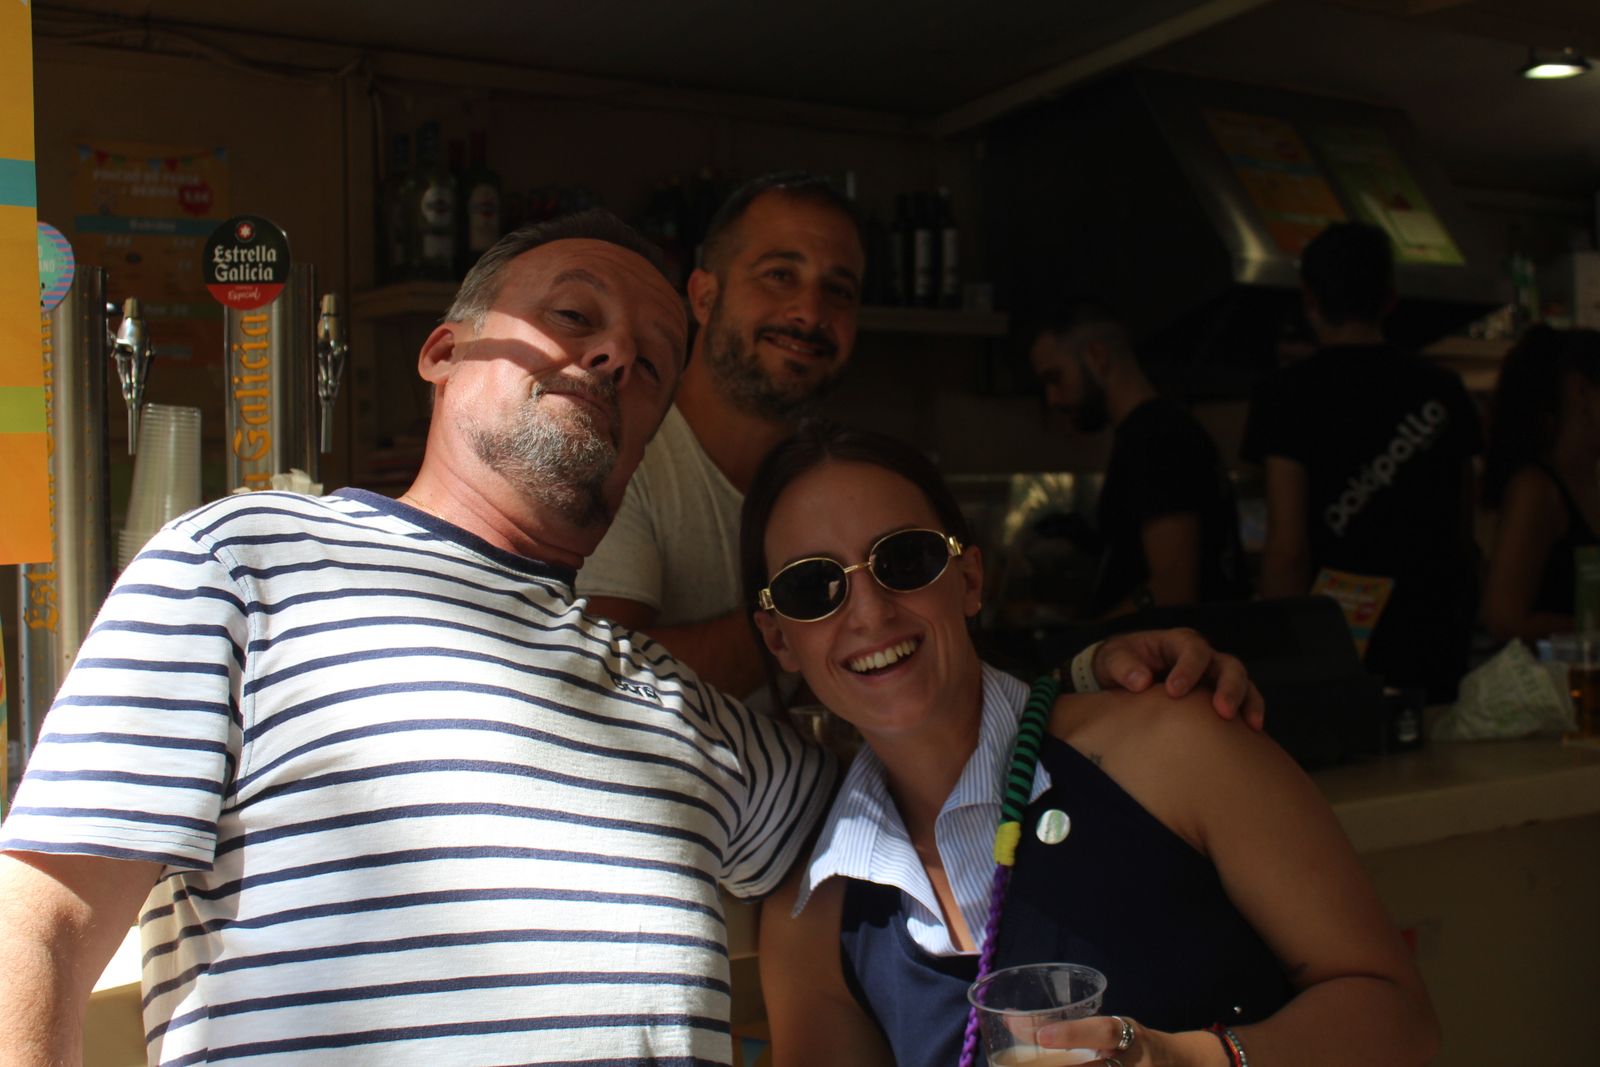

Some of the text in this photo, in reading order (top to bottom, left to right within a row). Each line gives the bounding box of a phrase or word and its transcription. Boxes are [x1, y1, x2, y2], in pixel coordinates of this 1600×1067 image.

[212, 244, 277, 264] Estrella
[214, 262, 274, 282] Galicia
[231, 314, 272, 461] Galicia
